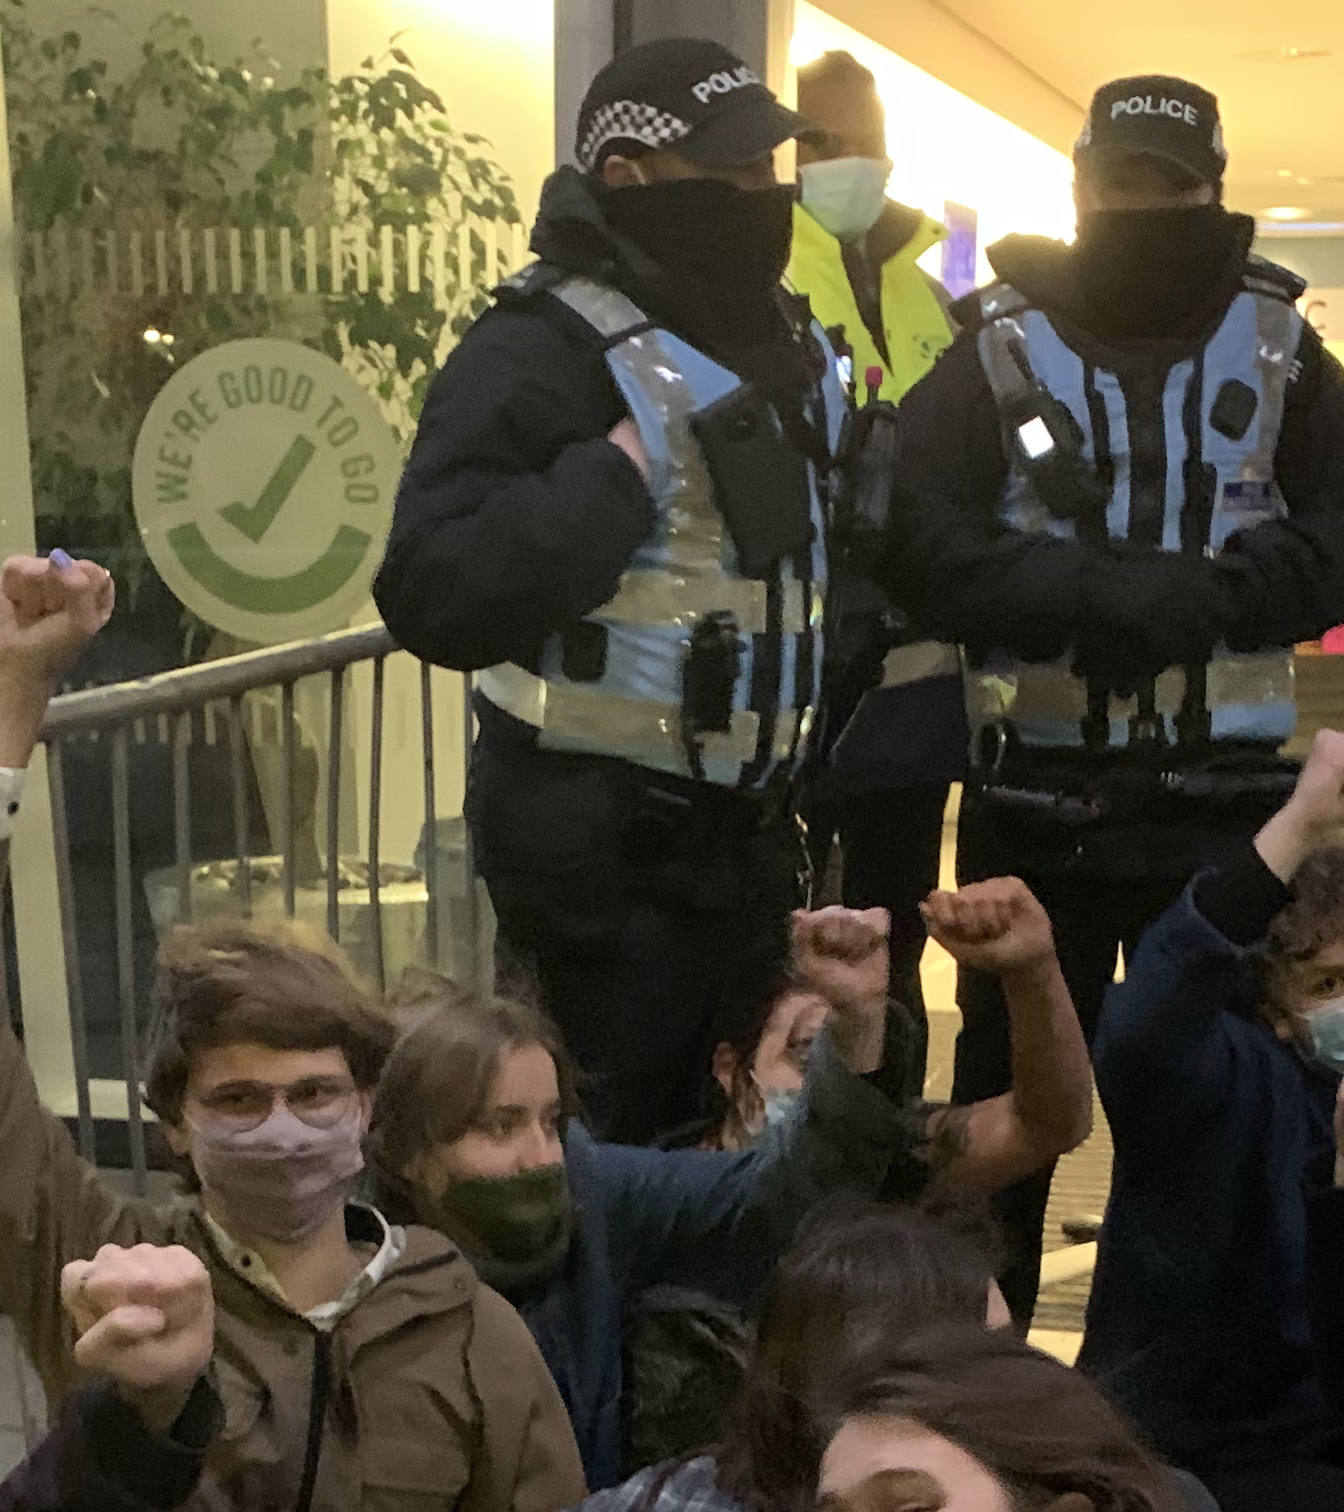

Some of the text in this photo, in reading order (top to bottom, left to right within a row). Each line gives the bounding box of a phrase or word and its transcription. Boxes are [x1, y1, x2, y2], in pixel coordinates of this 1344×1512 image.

[1110, 95, 1198, 125] POLICE
[156, 365, 380, 505] WE'RE GOOD TO GO
